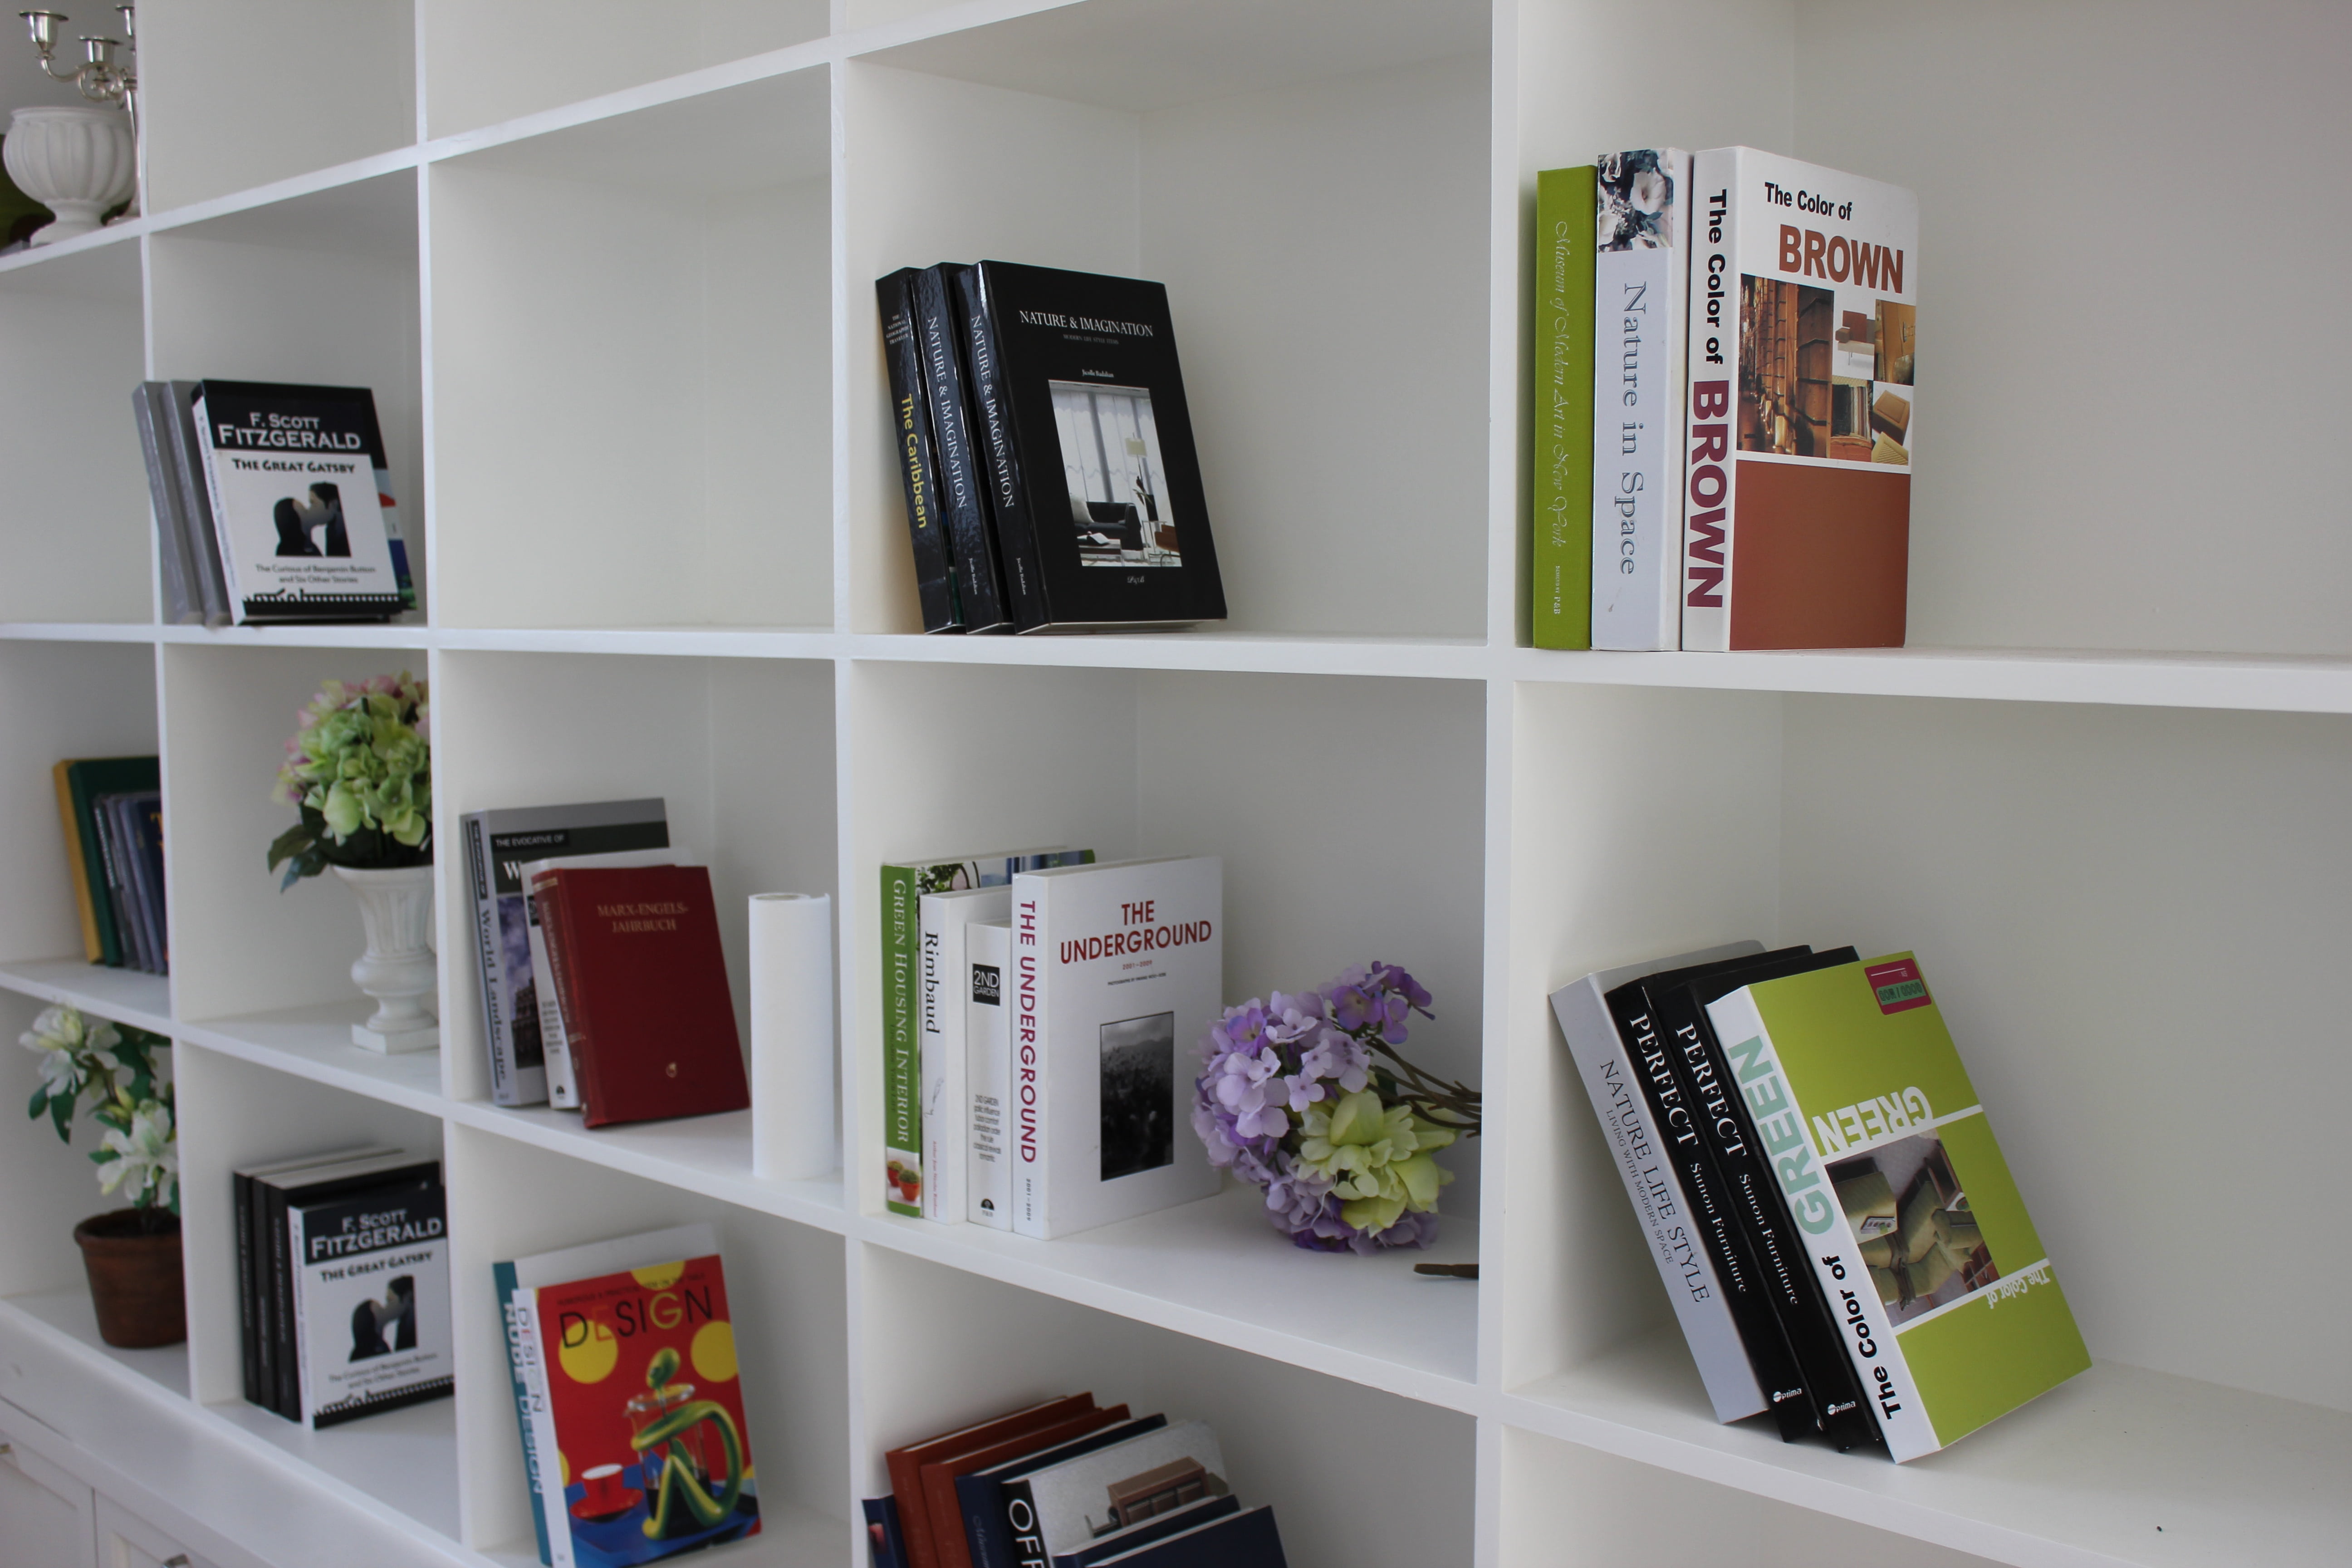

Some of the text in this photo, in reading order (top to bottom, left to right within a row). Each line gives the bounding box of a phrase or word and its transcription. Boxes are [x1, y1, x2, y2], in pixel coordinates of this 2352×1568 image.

[1765, 182, 1852, 221] The Color of
[1779, 224, 1903, 294] BROWN
[1019, 310, 1153, 337] NATURE & IMAGINATION
[1550, 298, 1569, 316] of
[250, 412, 320, 430] F. SCOTT
[928, 316, 967, 508] NATURE & IMAGINATION
[971, 315, 1014, 508] NATURE & IMAGINATION
[1554, 388, 1569, 420] Art
[1614, 280, 1647, 575] Nature in Space
[1687, 189, 1730, 608] The Color of BROWN
[218, 423, 361, 450] FITZGERALD
[902, 393, 927, 529] The Caribbean
[1554, 428, 1566, 439] in
[231, 457, 355, 474] THE GREAT GATSBY
[496, 838, 510, 847] THE
[512, 835, 552, 846] EVOCATIVE
[482, 910, 495, 968] World
[1061, 921, 1211, 964] UNDERGROUND
[1122, 900, 1154, 926] THE
[926, 931, 940, 1034] Rimbaud
[974, 970, 999, 988] 2ND
[974, 986, 999, 997] GARDEN
[893, 879, 909, 1142] GREEN HOUSING INTERIOR
[1020, 901, 1036, 1163] THE UNDERGROUND
[1812, 1086, 1934, 1156] GREEN
[1600, 1059, 1710, 1303] NATURE LIFE STYLE
[1630, 1013, 1747, 1294] PERFECT Sunon Furniture
[1676, 1022, 1798, 1306] PERFECT Sunon Furniture
[1607, 1109, 1673, 1264] LIVING WITH MODERN SPACE
[310, 1216, 442, 1259] FITZGERALD
[358, 1208, 407, 1229] SCOTT
[1727, 1035, 1902, 1421] The Color of GREEN
[560, 1285, 712, 1349] DESIGN
[1985, 1269, 2050, 1309] The Color of
[504, 1302, 543, 1494] NUDE DESIGN
